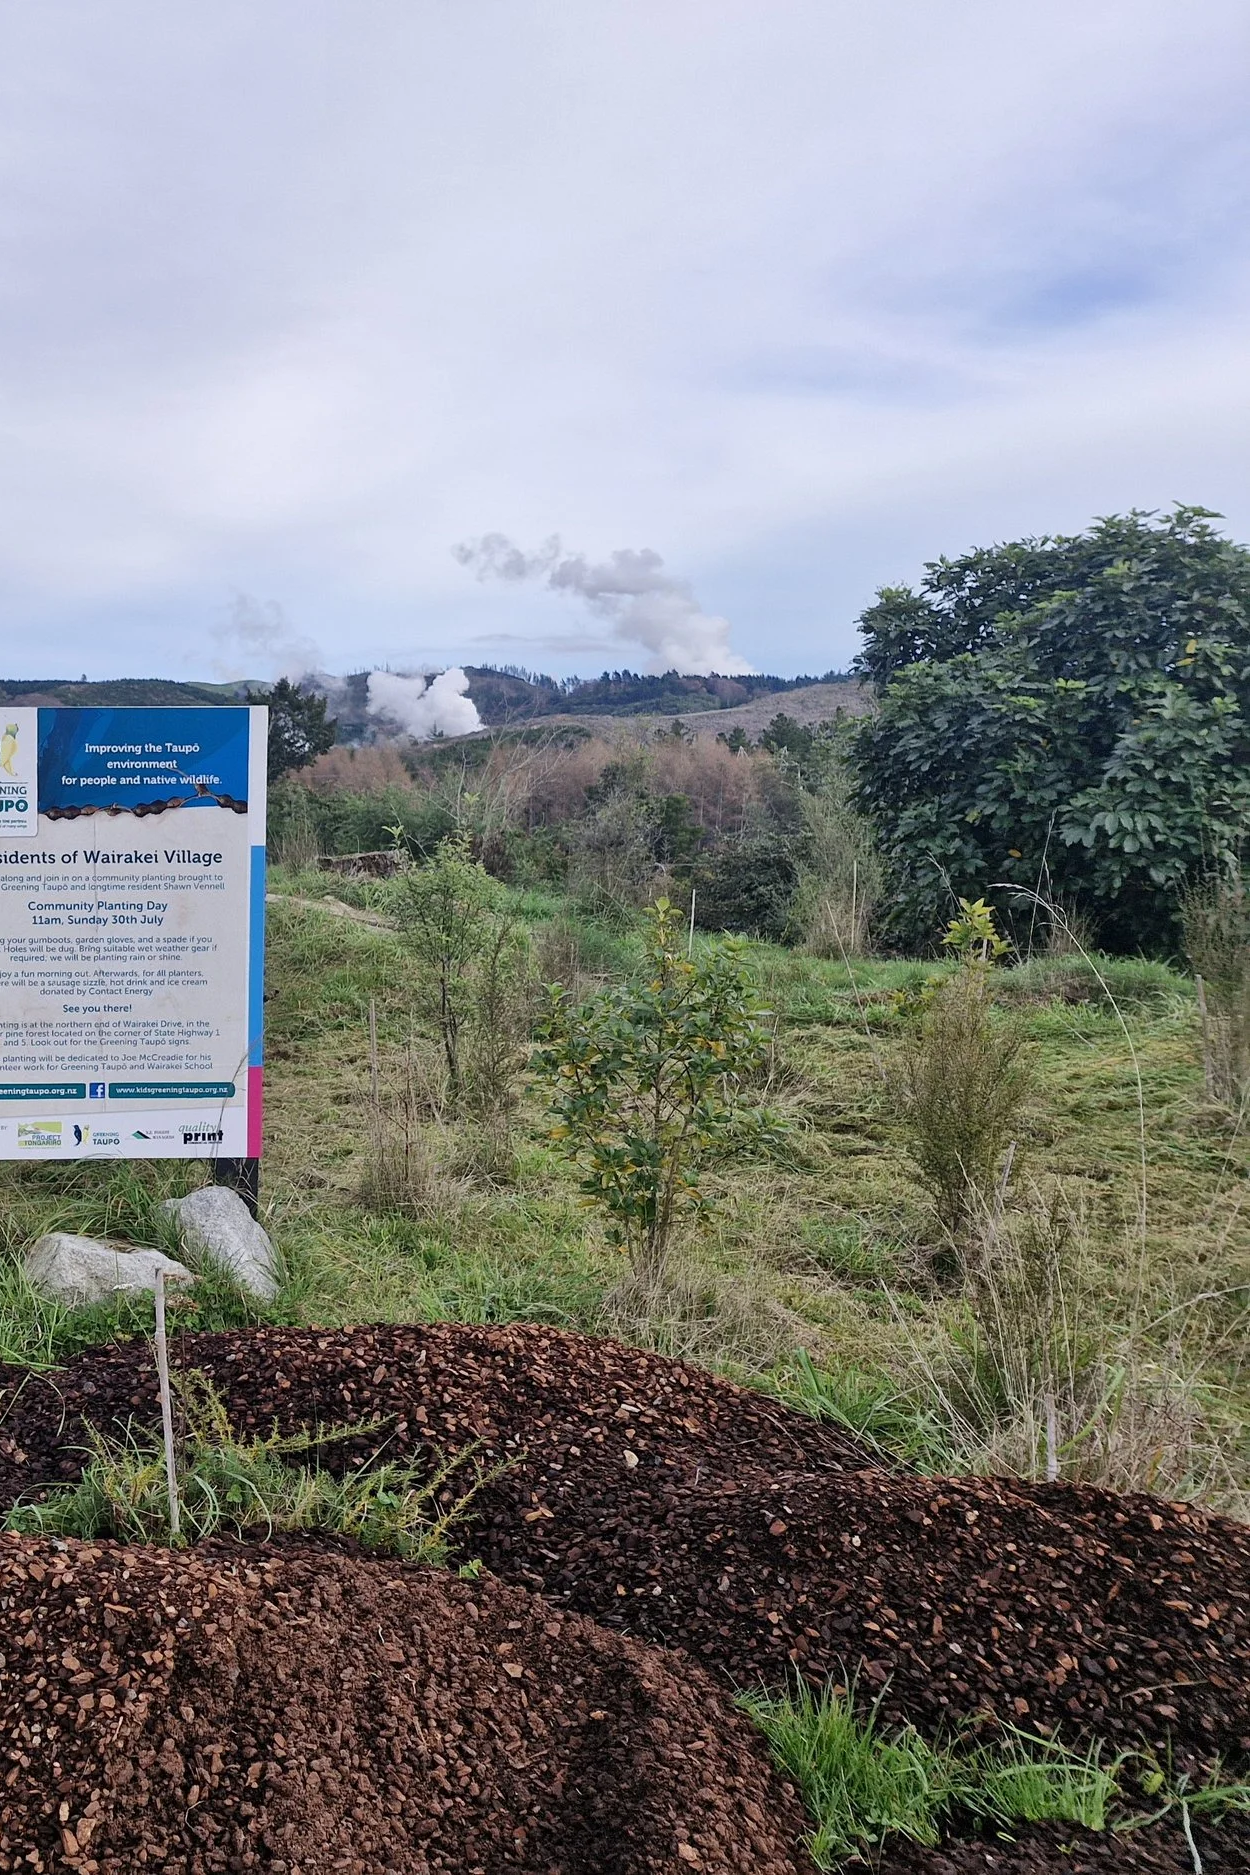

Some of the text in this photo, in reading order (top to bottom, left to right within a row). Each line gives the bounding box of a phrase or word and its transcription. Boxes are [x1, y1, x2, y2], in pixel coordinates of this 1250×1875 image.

[84, 743, 142, 754] Improving
[145, 743, 162, 752] the
[107, 759, 177, 768] environment
[61, 775, 223, 787] for people and native wildlife.
[61, 850, 78, 864] of
[84, 850, 158, 864] Wairakei
[164, 850, 223, 867] Village
[0, 874, 24, 883] along
[26, 874, 42, 882] and
[44, 874, 59, 883] join
[62, 874, 69, 882] in
[92, 874, 139, 883] community
[142, 874, 176, 883] planting
[178, 873, 211, 883] brought
[214, 873, 223, 881] to
[1, 883, 39, 892] Greening
[70, 883, 86, 891] and
[89, 883, 125, 892] longtime
[194, 882, 225, 890] Vennell
[28, 900, 168, 912] Community Planting Day
[32, 915, 164, 926] 11am, Sunday 30th July
[7, 938, 26, 946] your
[75, 936, 104, 945] garden
[138, 935, 153, 943] and
[163, 935, 187, 945] spade
[189, 935, 194, 943] if
[4, 945, 27, 953] Holes
[29, 945, 43, 953] will
[79, 945, 101, 954] Bring
[103, 944, 135, 952] suitable
[137, 944, 153, 952] wet
[155, 944, 189, 952] weather
[212, 944, 217, 952] if
[64, 953, 78, 961] will
[81, 953, 91, 961] be
[93, 953, 127, 963] planting
[130, 953, 145, 961] rain
[37, 970, 72, 979] morning
[143, 969, 154, 977] for
[157, 969, 166, 977] all
[11, 978, 26, 986] will
[28, 978, 38, 986] be
[48, 980, 80, 988] sausage
[110, 978, 124, 986] hot
[126, 978, 147, 986] drink
[150, 978, 165, 986] and
[167, 978, 179, 986] ice
[39, 987, 153, 996] donated by Contact Energy
[62, 1004, 132, 1014] See you there!
[21, 1020, 27, 1028] is
[29, 1020, 37, 1028] at
[40, 1020, 53, 1028] the
[56, 1020, 92, 1028] northern
[94, 1020, 110, 1028] end
[112, 1020, 121, 1028] of
[123, 1020, 158, 1028] Wairakei
[186, 1020, 194, 1028] in
[196, 1020, 210, 1028] the
[6, 1029, 23, 1039] pine
[26, 1029, 49, 1037] forest
[52, 1029, 82, 1037] located
[98, 1029, 111, 1037] the
[143, 1029, 152, 1037] of
[154, 1029, 175, 1037] State
[178, 1029, 213, 1038] Highway
[3, 1038, 19, 1046] and
[31, 1038, 51, 1046] Look
[53, 1038, 67, 1046] out
[70, 1038, 81, 1046] for
[84, 1038, 97, 1046] the
[99, 1038, 137, 1047] Greening
[3, 1054, 36, 1064] planting
[39, 1054, 53, 1062] will
[55, 1054, 65, 1062] be
[68, 1054, 108, 1062] dedicated
[111, 1054, 119, 1062] to
[186, 1053, 197, 1061] for
[200, 1053, 212, 1061] his
[24, 1063, 44, 1071] work
[61, 1063, 99, 1072] Greening
[129, 1062, 145, 1070] and
[147, 1062, 182, 1070] Wairakei
[185, 1062, 213, 1070] School
[115, 1086, 228, 1095] www.kidsgreeningtaupo.org.nz
[178, 1121, 217, 1133] quality
[183, 1129, 224, 1144] print
